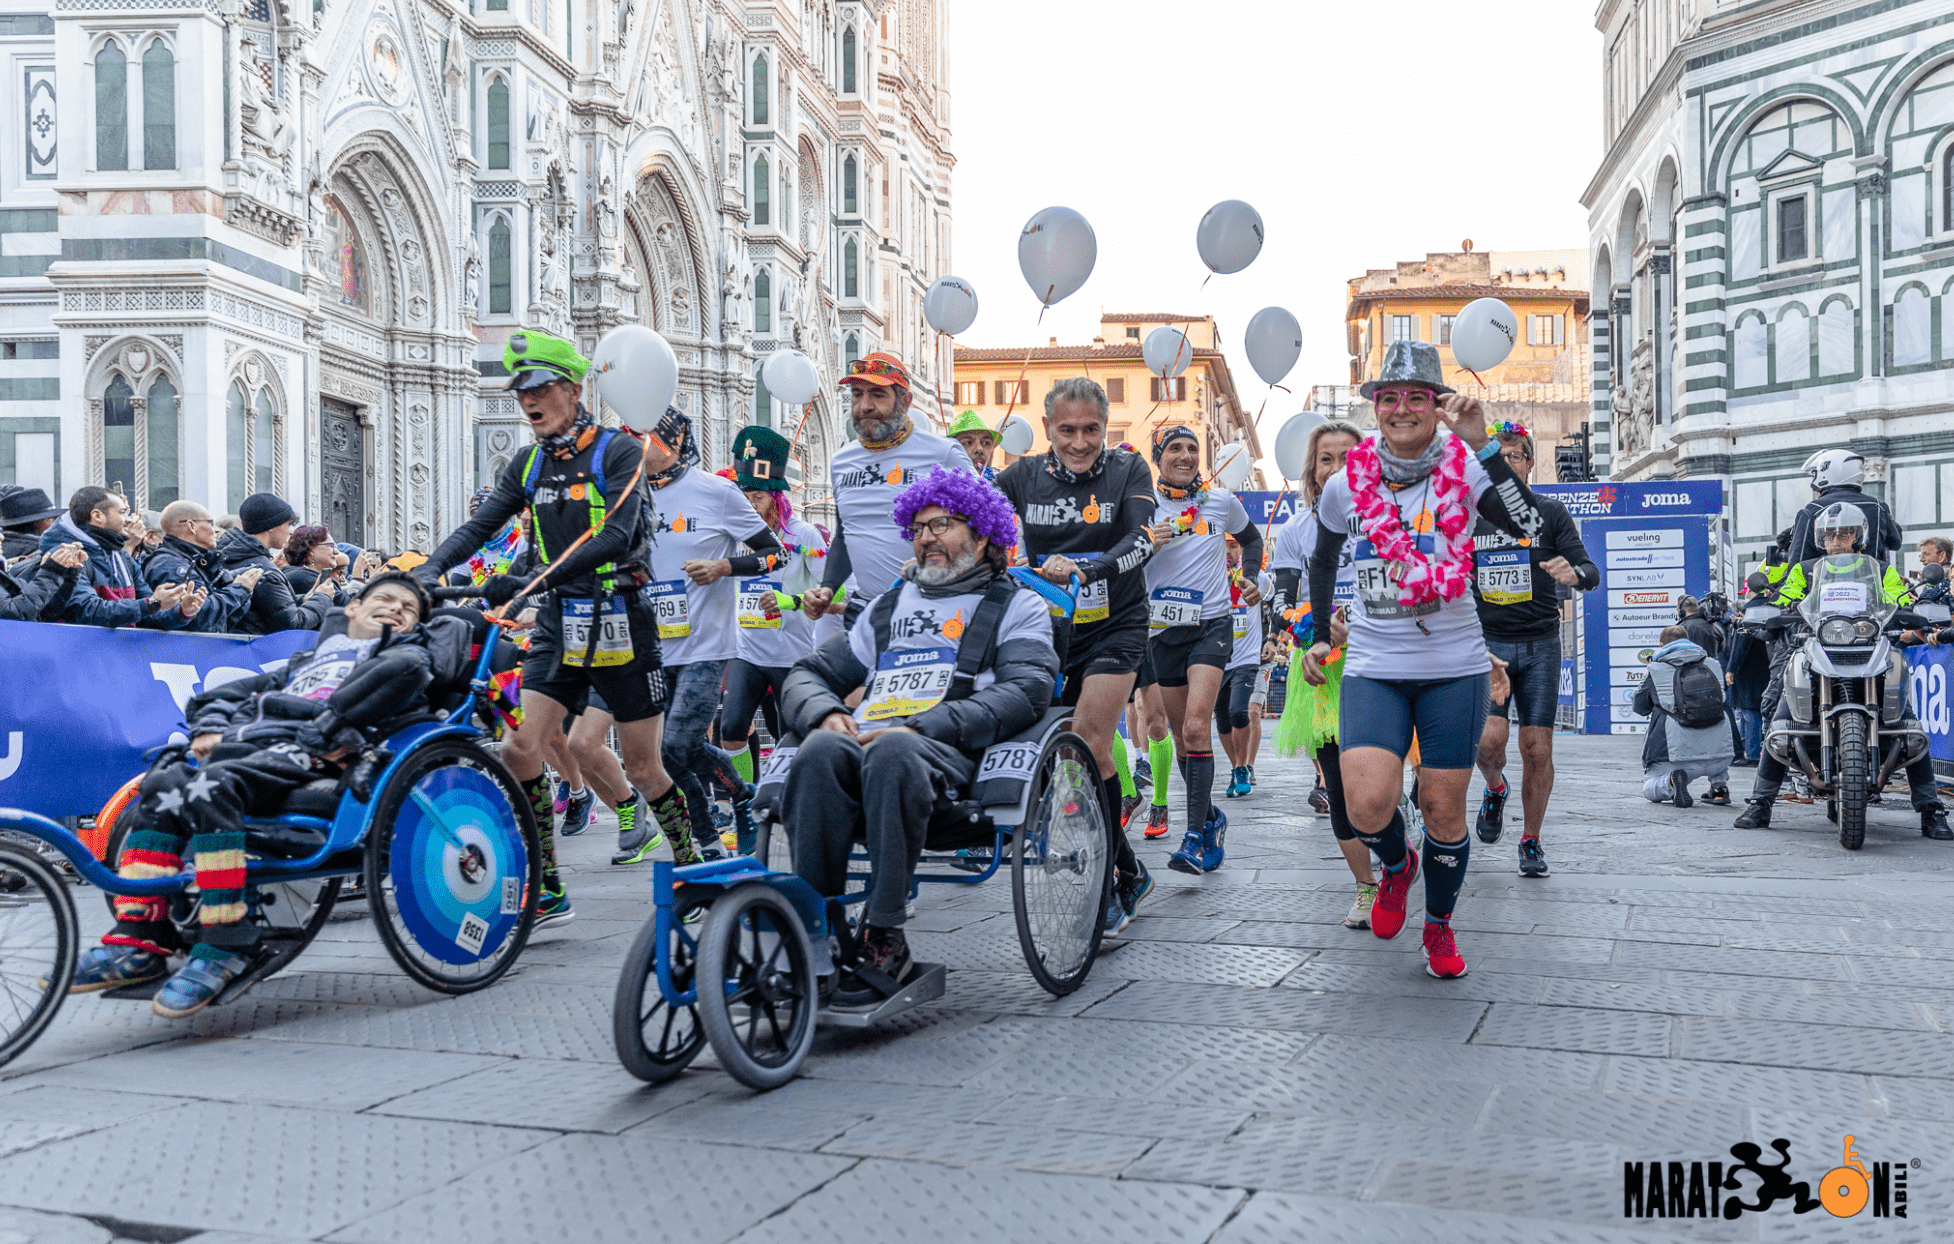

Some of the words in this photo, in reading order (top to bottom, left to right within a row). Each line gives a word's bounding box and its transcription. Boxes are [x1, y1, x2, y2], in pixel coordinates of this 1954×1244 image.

[1627, 532, 1661, 543] vueling
[1489, 570, 1519, 586] 5773
[1639, 593, 1669, 604] ENERVIT
[1160, 605, 1184, 622] 451
[887, 671, 934, 693] 5787
[983, 749, 1040, 772] 5787
